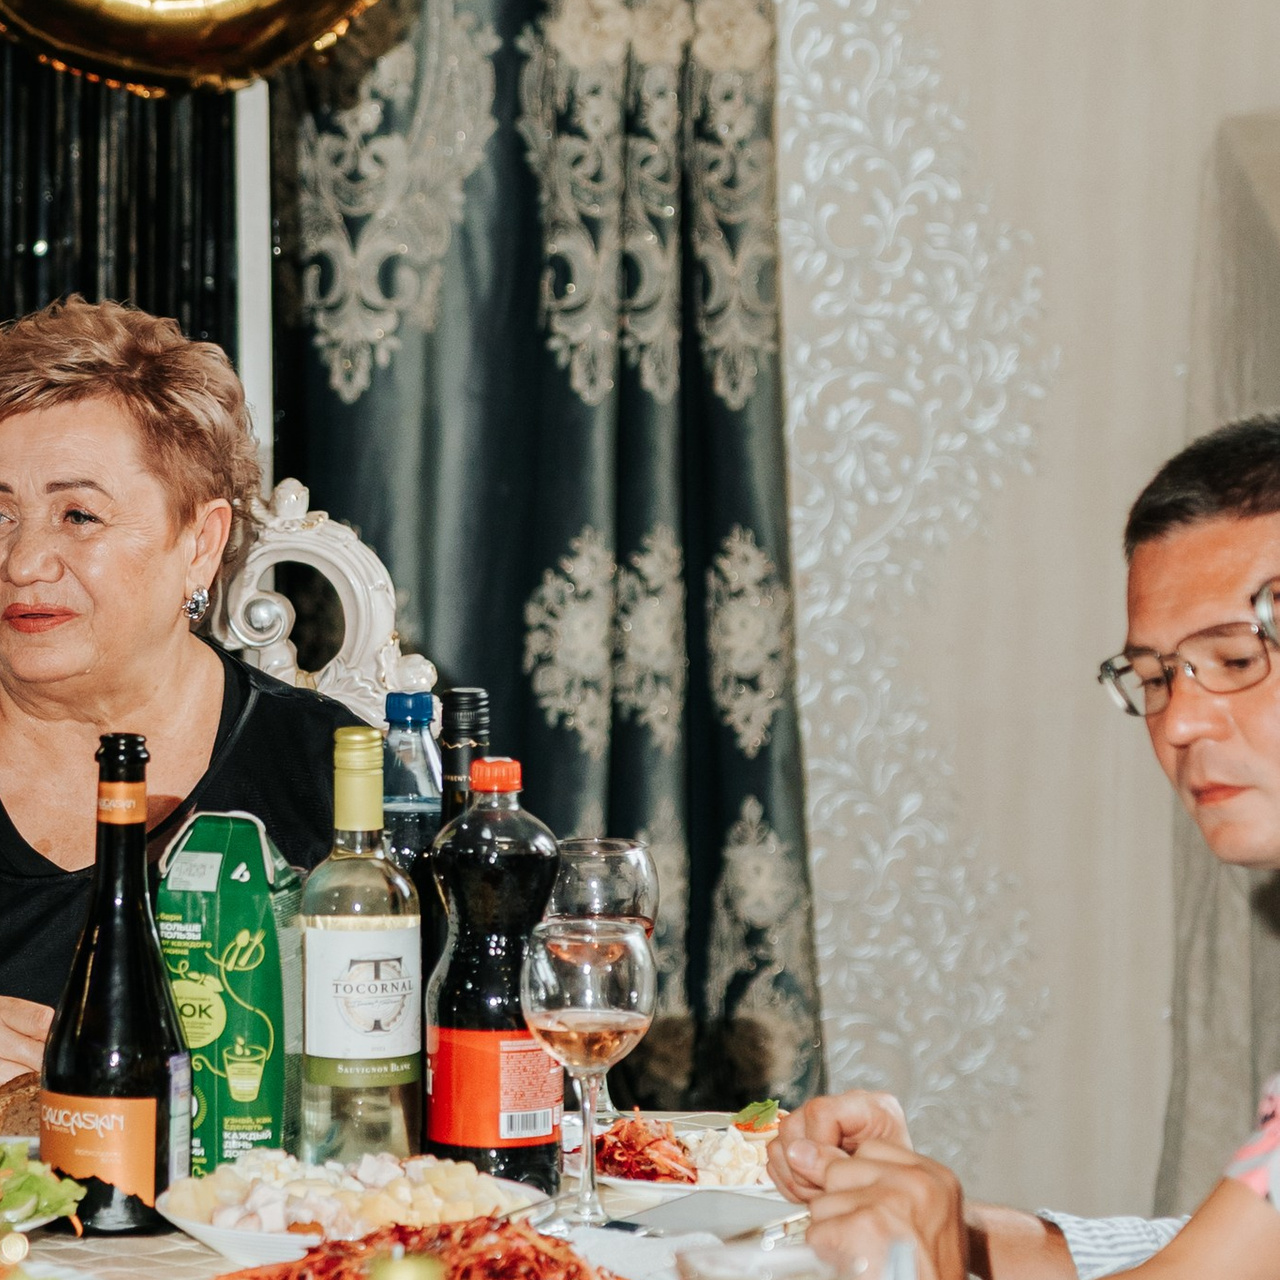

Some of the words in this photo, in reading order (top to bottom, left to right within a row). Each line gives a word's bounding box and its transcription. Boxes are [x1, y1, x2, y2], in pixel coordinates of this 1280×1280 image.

[159, 922, 202, 932] БОЛЬШЕ
[160, 931, 202, 940] ПОЛЬЗЫ
[332, 980, 414, 995] TOCORNAL
[223, 1129, 272, 1141] КАЖДЫЙ
[223, 1140, 253, 1149] ДЕНЬ
